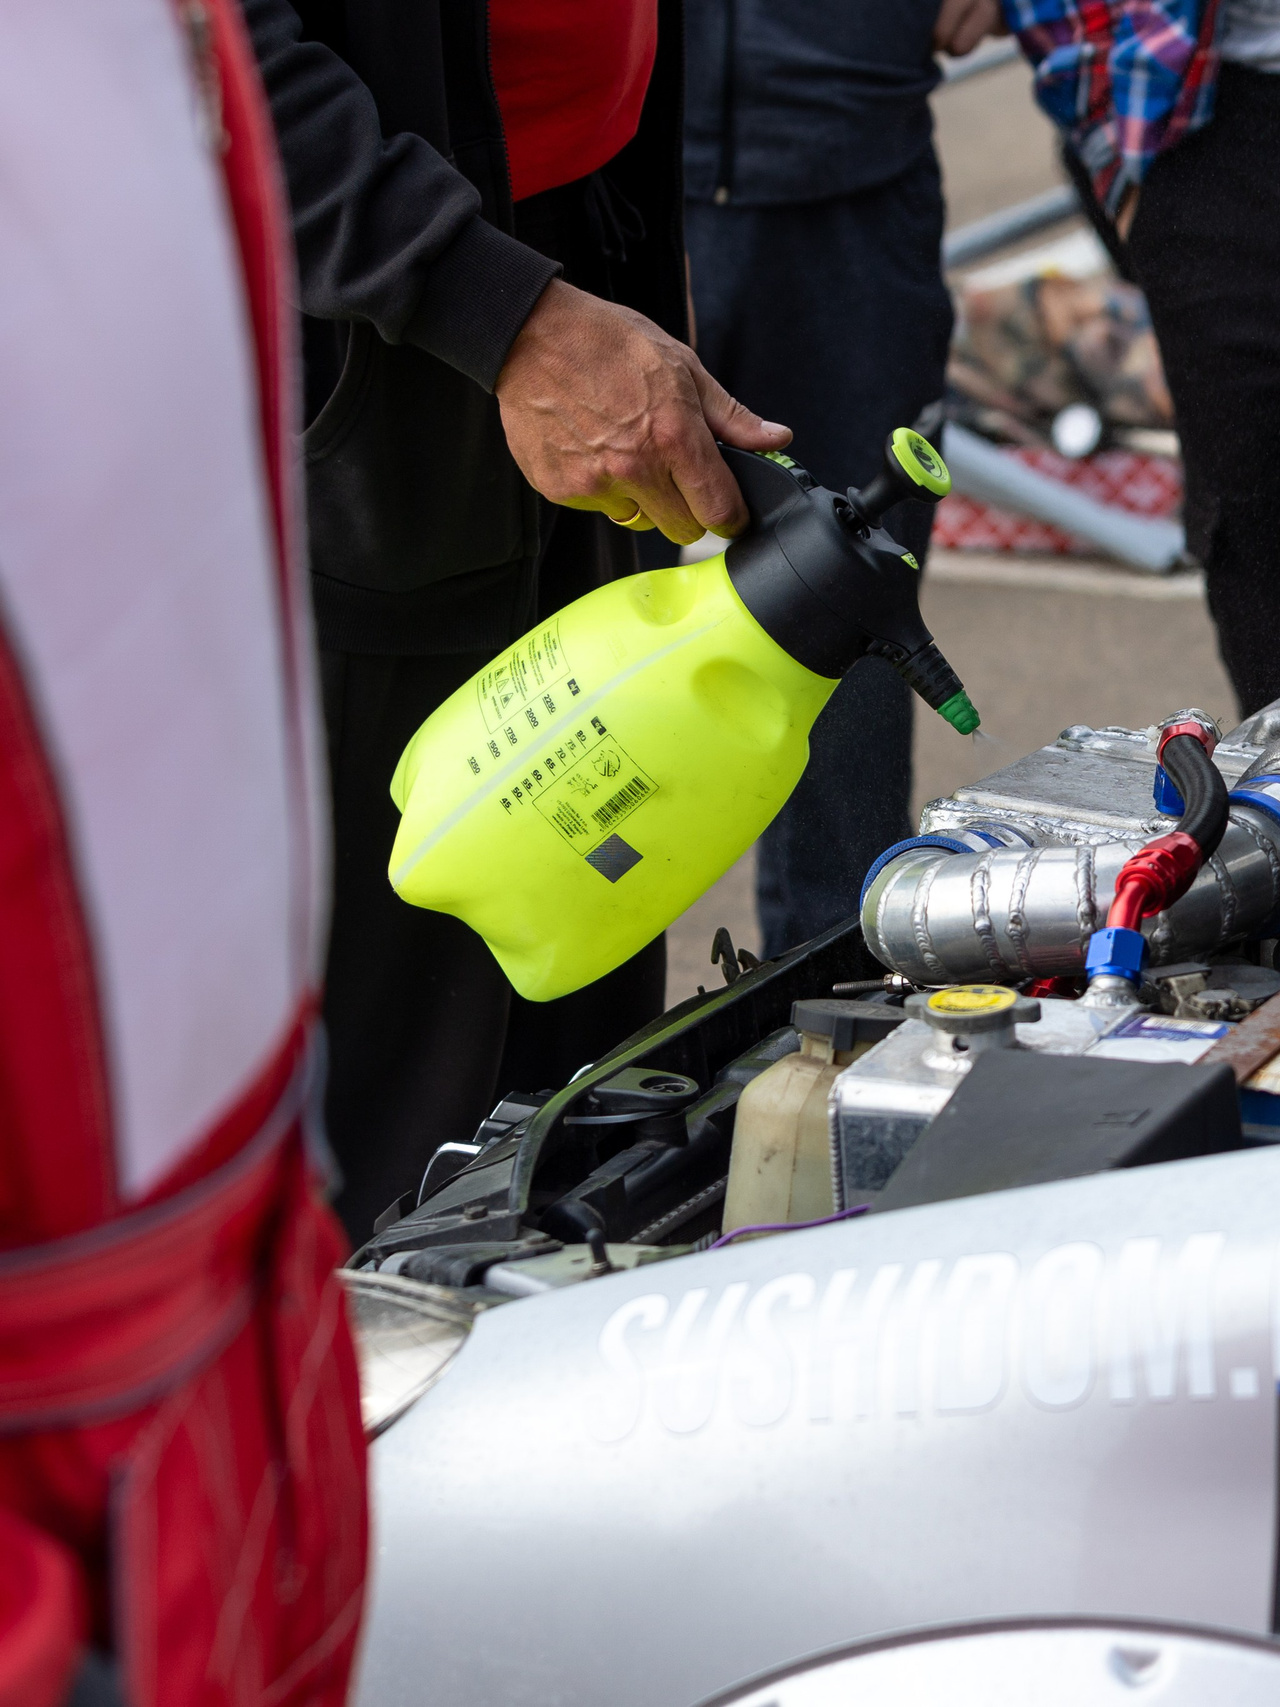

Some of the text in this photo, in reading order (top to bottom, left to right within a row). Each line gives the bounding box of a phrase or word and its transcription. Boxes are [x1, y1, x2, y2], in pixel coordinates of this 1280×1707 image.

[543, 693, 556, 714] 2250
[526, 707, 539, 728] 2000
[505, 726, 518, 745] 1750
[576, 729, 587, 742] 80
[489, 739, 501, 758] 1500
[567, 738, 577, 751] 75
[556, 747, 567, 759] 70
[469, 756, 481, 774] 1250
[545, 757, 556, 770] 65
[532, 769, 543, 781] 60
[522, 777, 533, 790] 55
[512, 786, 523, 798] 50
[501, 797, 512, 809] 45
